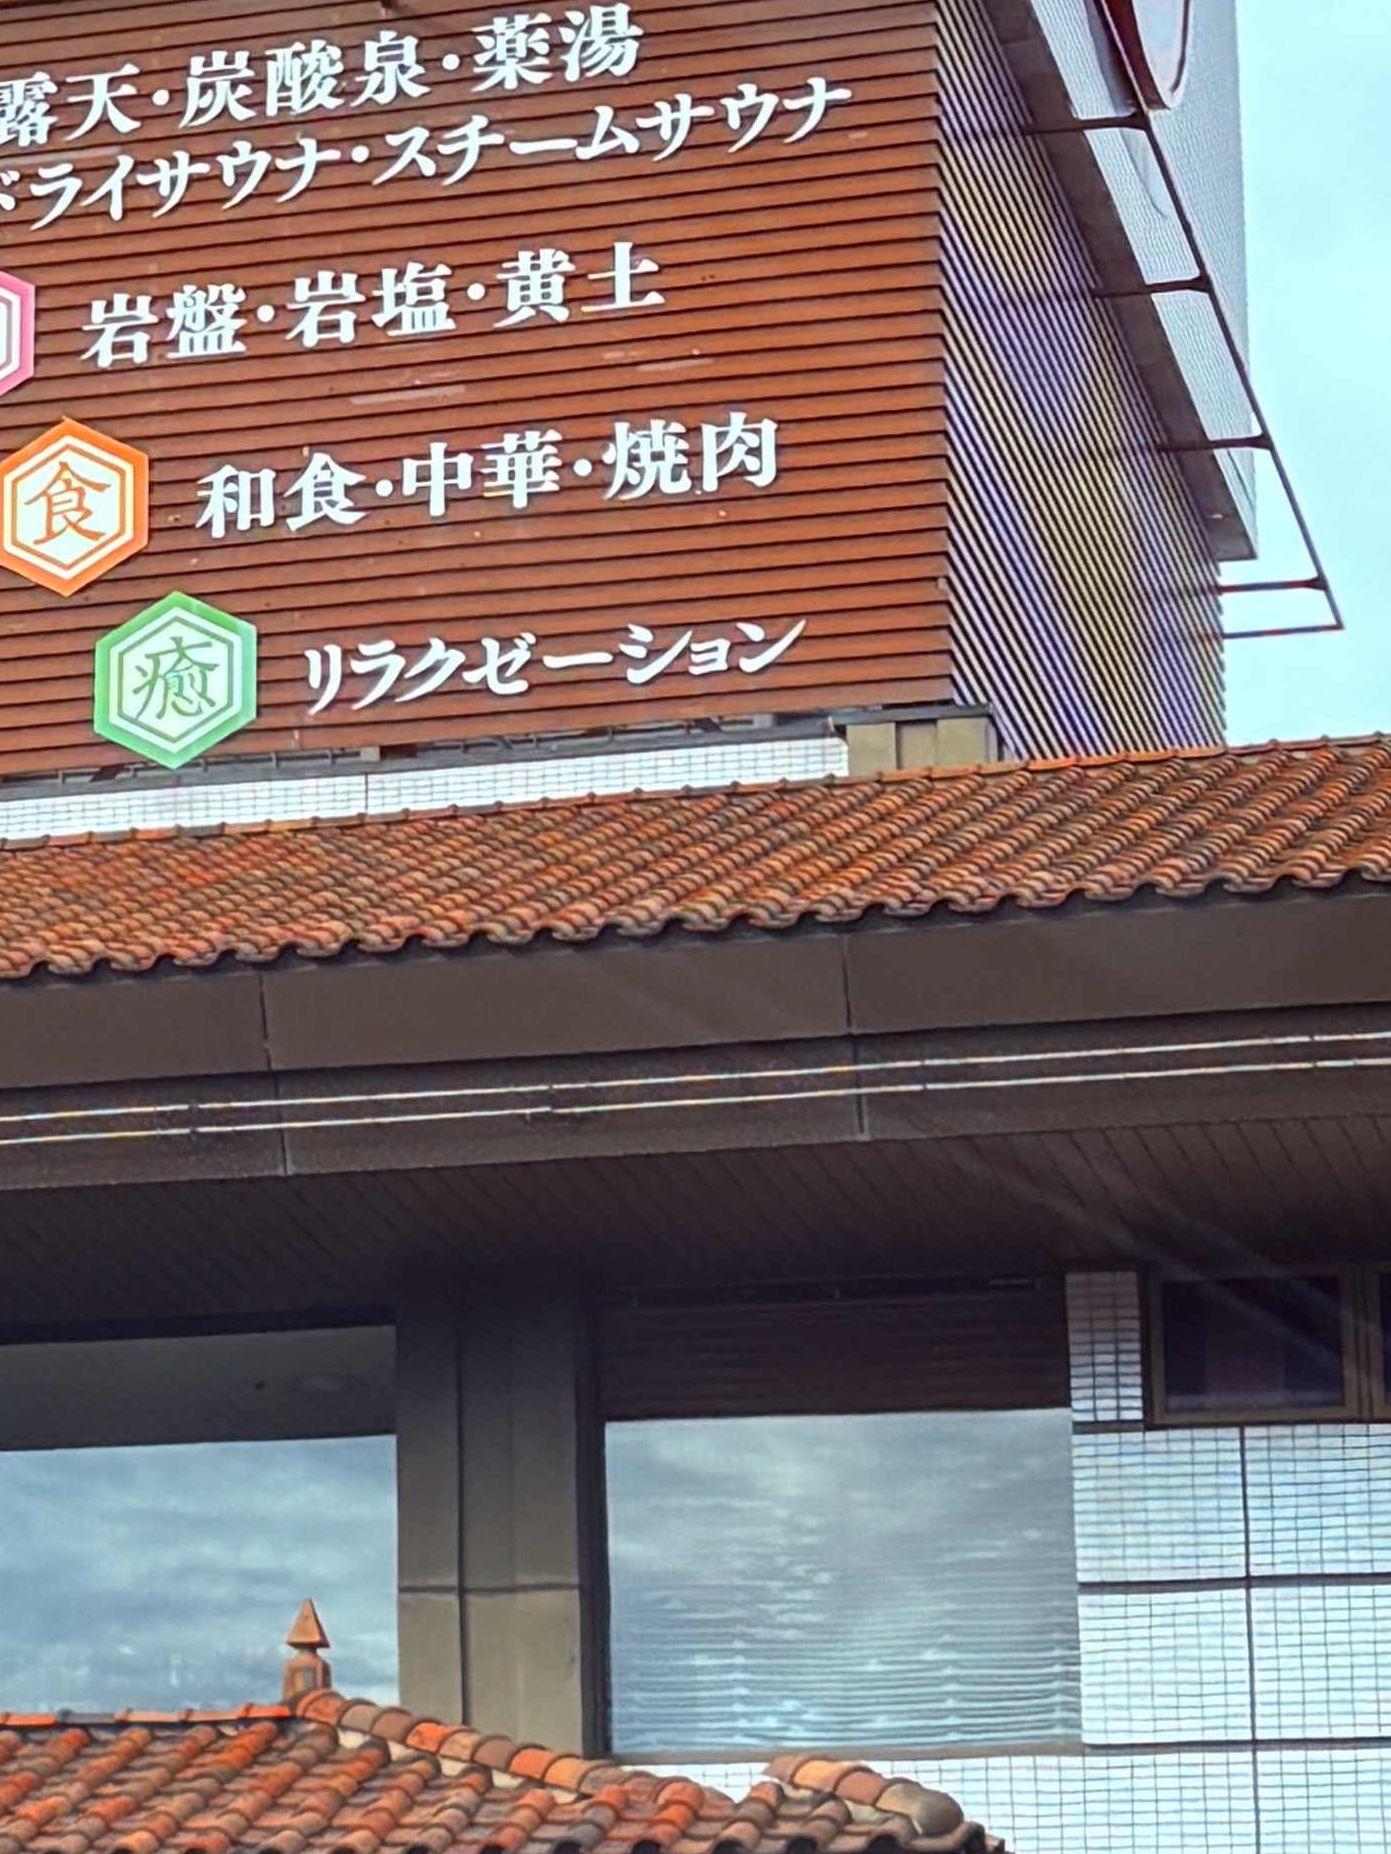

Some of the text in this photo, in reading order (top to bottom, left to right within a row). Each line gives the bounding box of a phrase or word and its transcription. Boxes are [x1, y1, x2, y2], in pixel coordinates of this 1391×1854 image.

[82, 241, 666, 368] 岩盤・岩塩・黄土
[25, 460, 113, 548] 食
[195, 413, 779, 539] 和食・中華・焼肉
[133, 633, 216, 724] 癒
[305, 618, 807, 714] リラクゼーション
